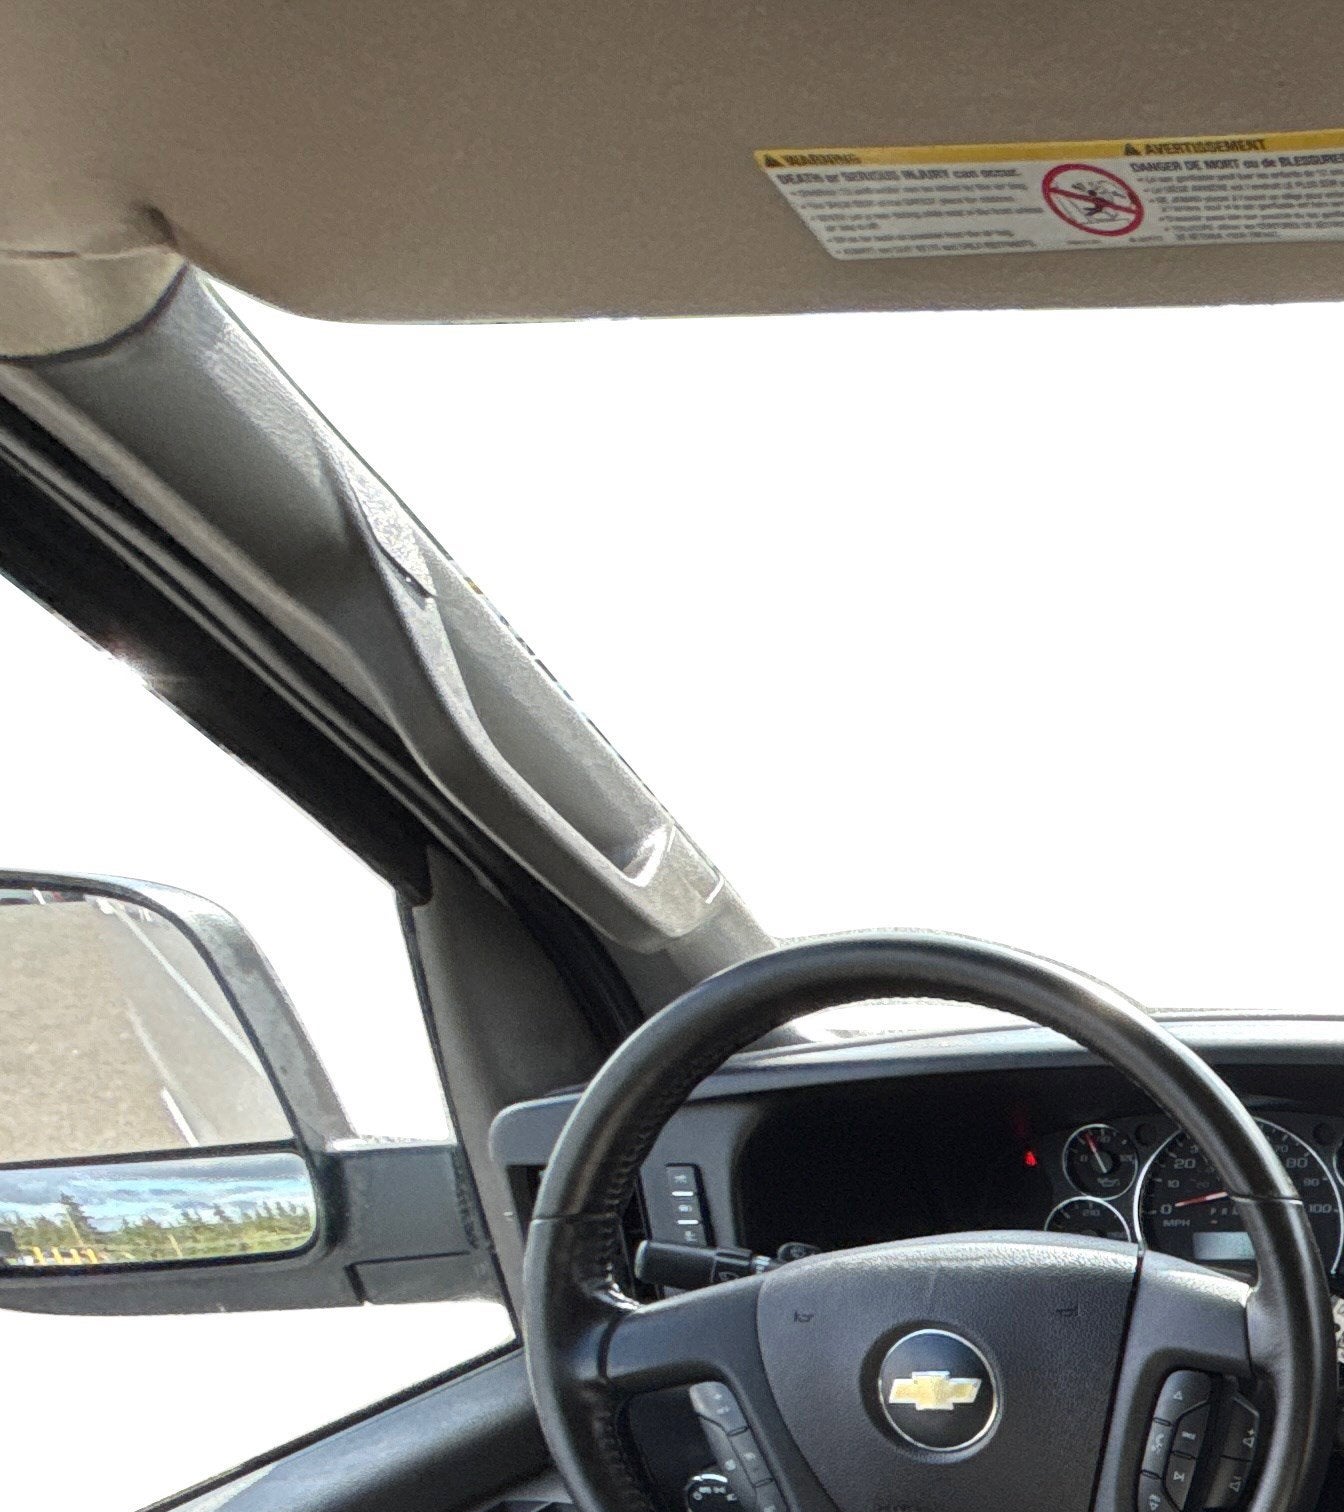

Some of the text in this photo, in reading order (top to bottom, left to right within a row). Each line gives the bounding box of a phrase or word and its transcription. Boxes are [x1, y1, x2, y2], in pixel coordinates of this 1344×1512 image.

[1130, 161, 1182, 172] DANGER
[1184, 160, 1199, 170] DE
[1204, 159, 1240, 169] MORT
[776, 173, 824, 184] DEATH
[1173, 1158, 1196, 1170] 20
[1286, 1157, 1309, 1169] 80
[1167, 1179, 1180, 1188] 10
[1302, 1178, 1320, 1187] 90
[1160, 1204, 1173, 1215] 0
[1307, 1203, 1333, 1213] 100
[1162, 1219, 1191, 1228] MPH
